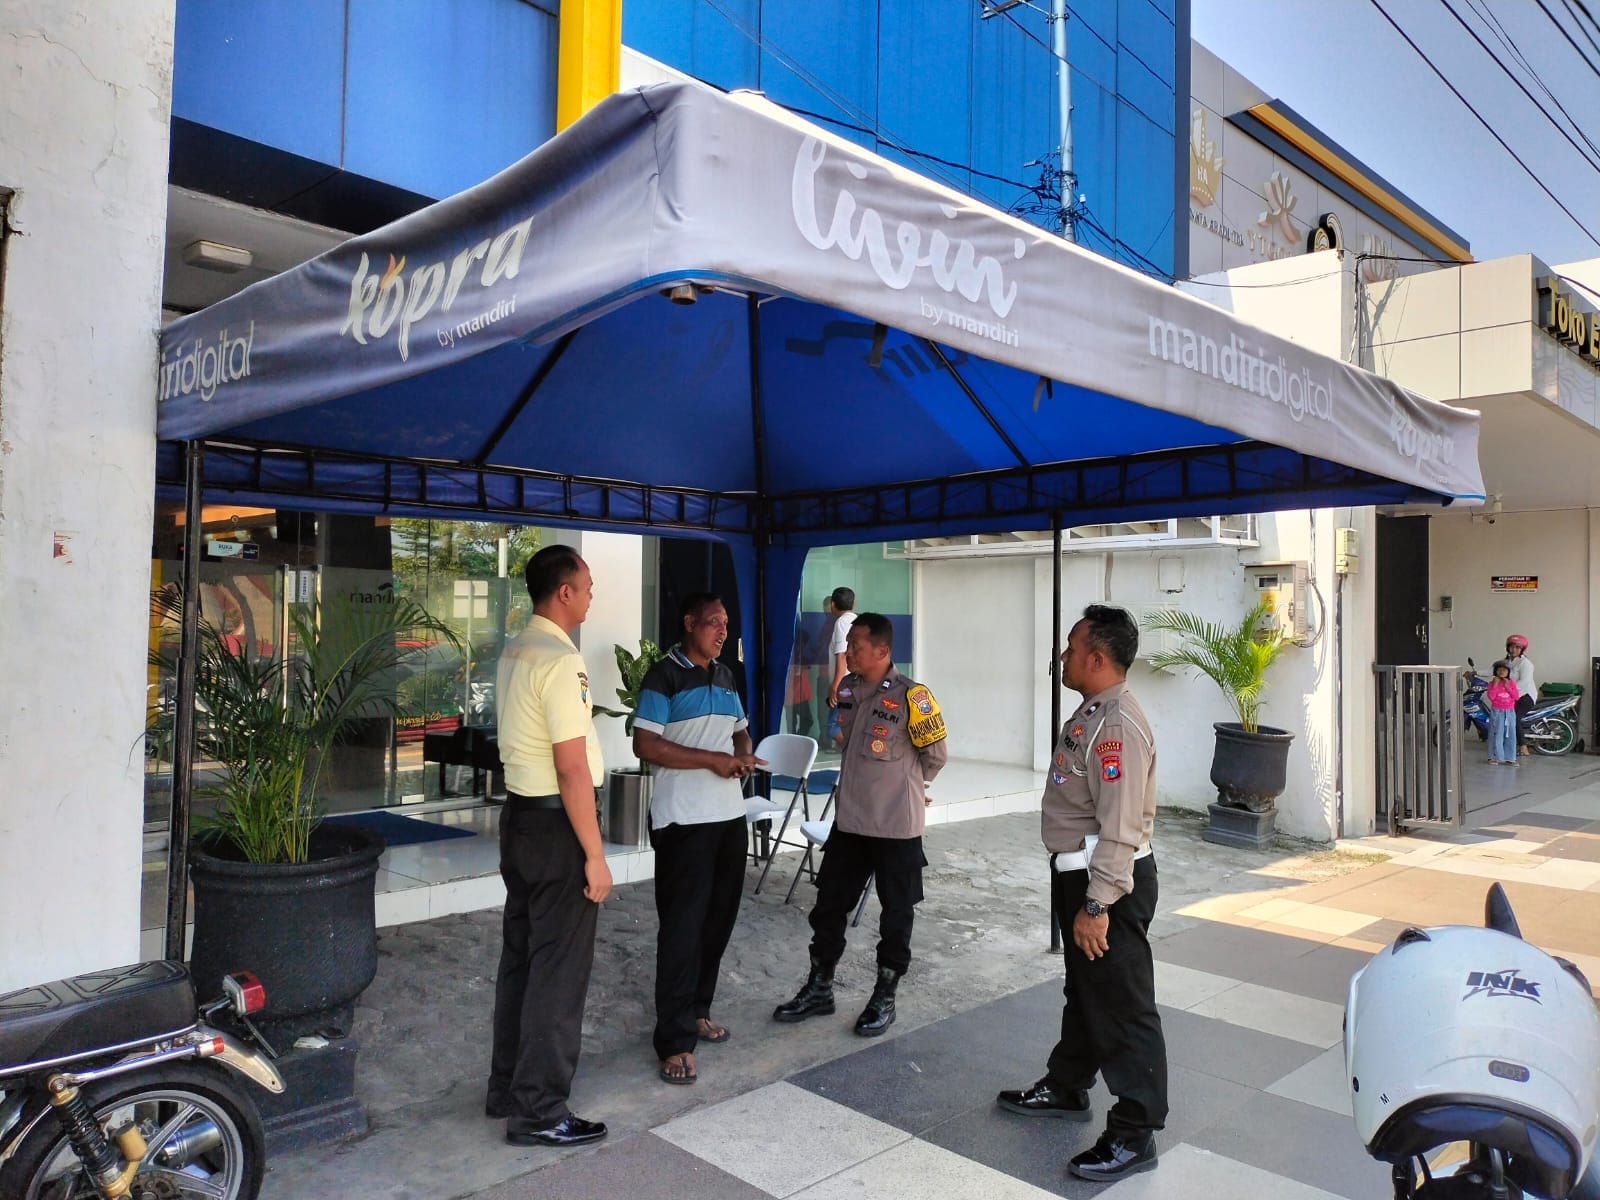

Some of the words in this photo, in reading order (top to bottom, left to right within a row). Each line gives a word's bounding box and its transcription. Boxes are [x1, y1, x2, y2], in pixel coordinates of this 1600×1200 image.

[340, 216, 534, 362] kopra
[1536, 276, 1586, 346] Toko
[437, 328, 455, 348] by
[456, 295, 517, 338] mandiri
[920, 296, 943, 326] by
[949, 311, 1020, 348] mandiri
[872, 709, 899, 724] POLRI
[1466, 970, 1541, 999] INK
